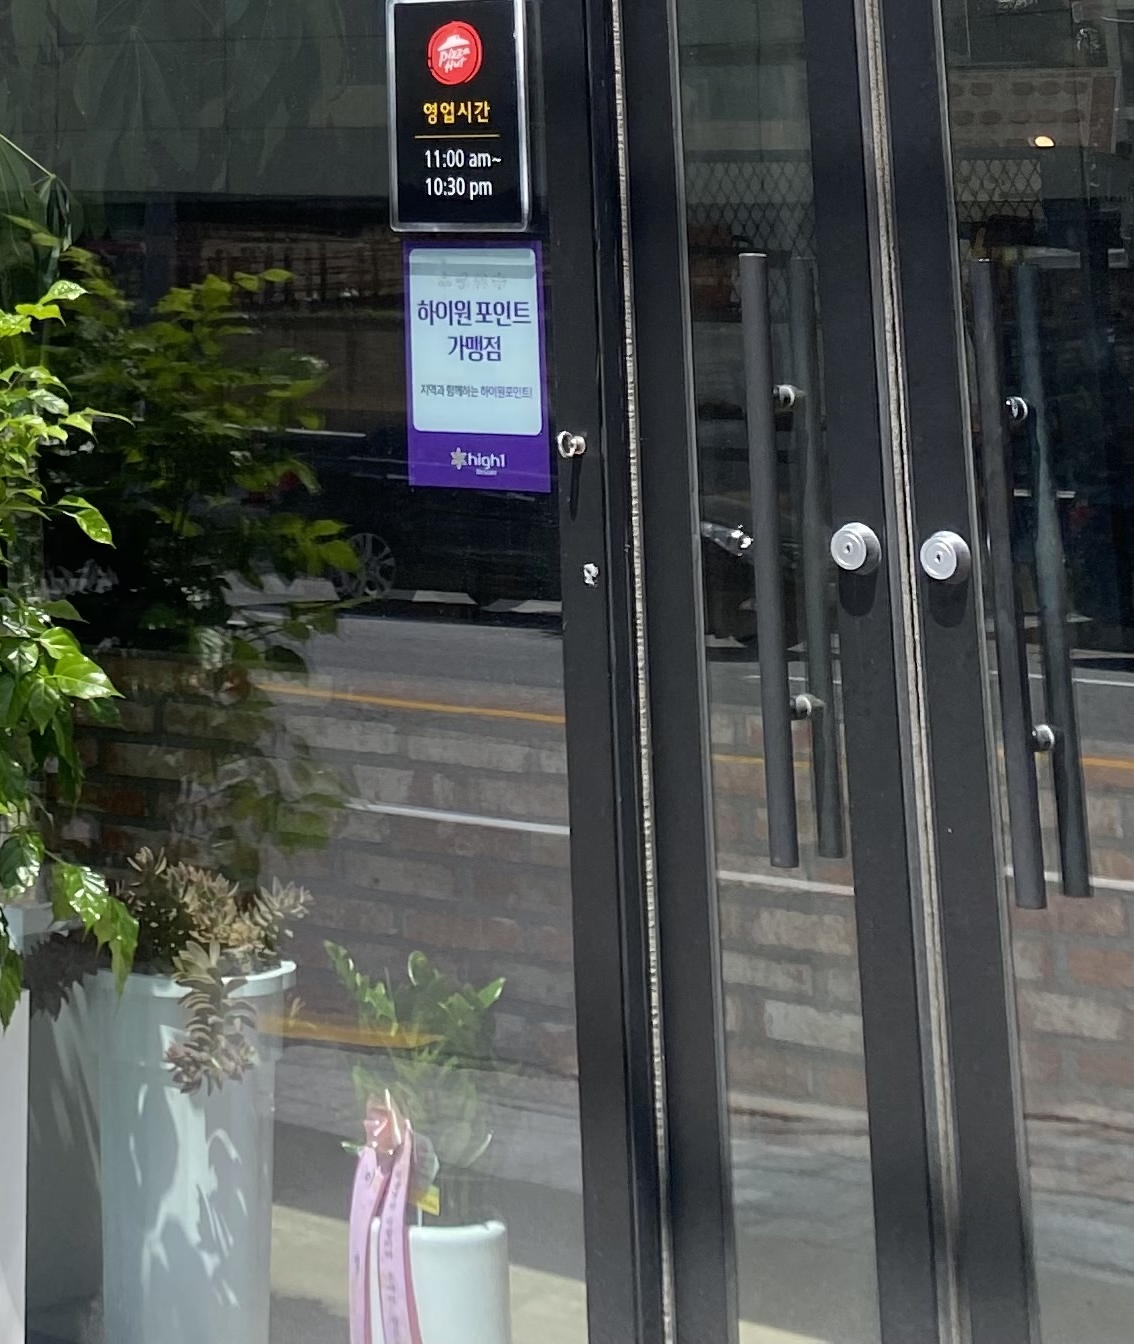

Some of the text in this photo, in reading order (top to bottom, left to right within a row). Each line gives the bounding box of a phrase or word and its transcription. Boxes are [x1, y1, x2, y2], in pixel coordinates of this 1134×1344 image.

[423, 100, 491, 125] 영업시간
[425, 149, 502, 169] 11:00 am~
[425, 177, 493, 200] 10:30 pm
[417, 300, 532, 327] 하이원 포인트
[447, 335, 502, 362] 가맹점
[468, 452, 506, 470] high1
